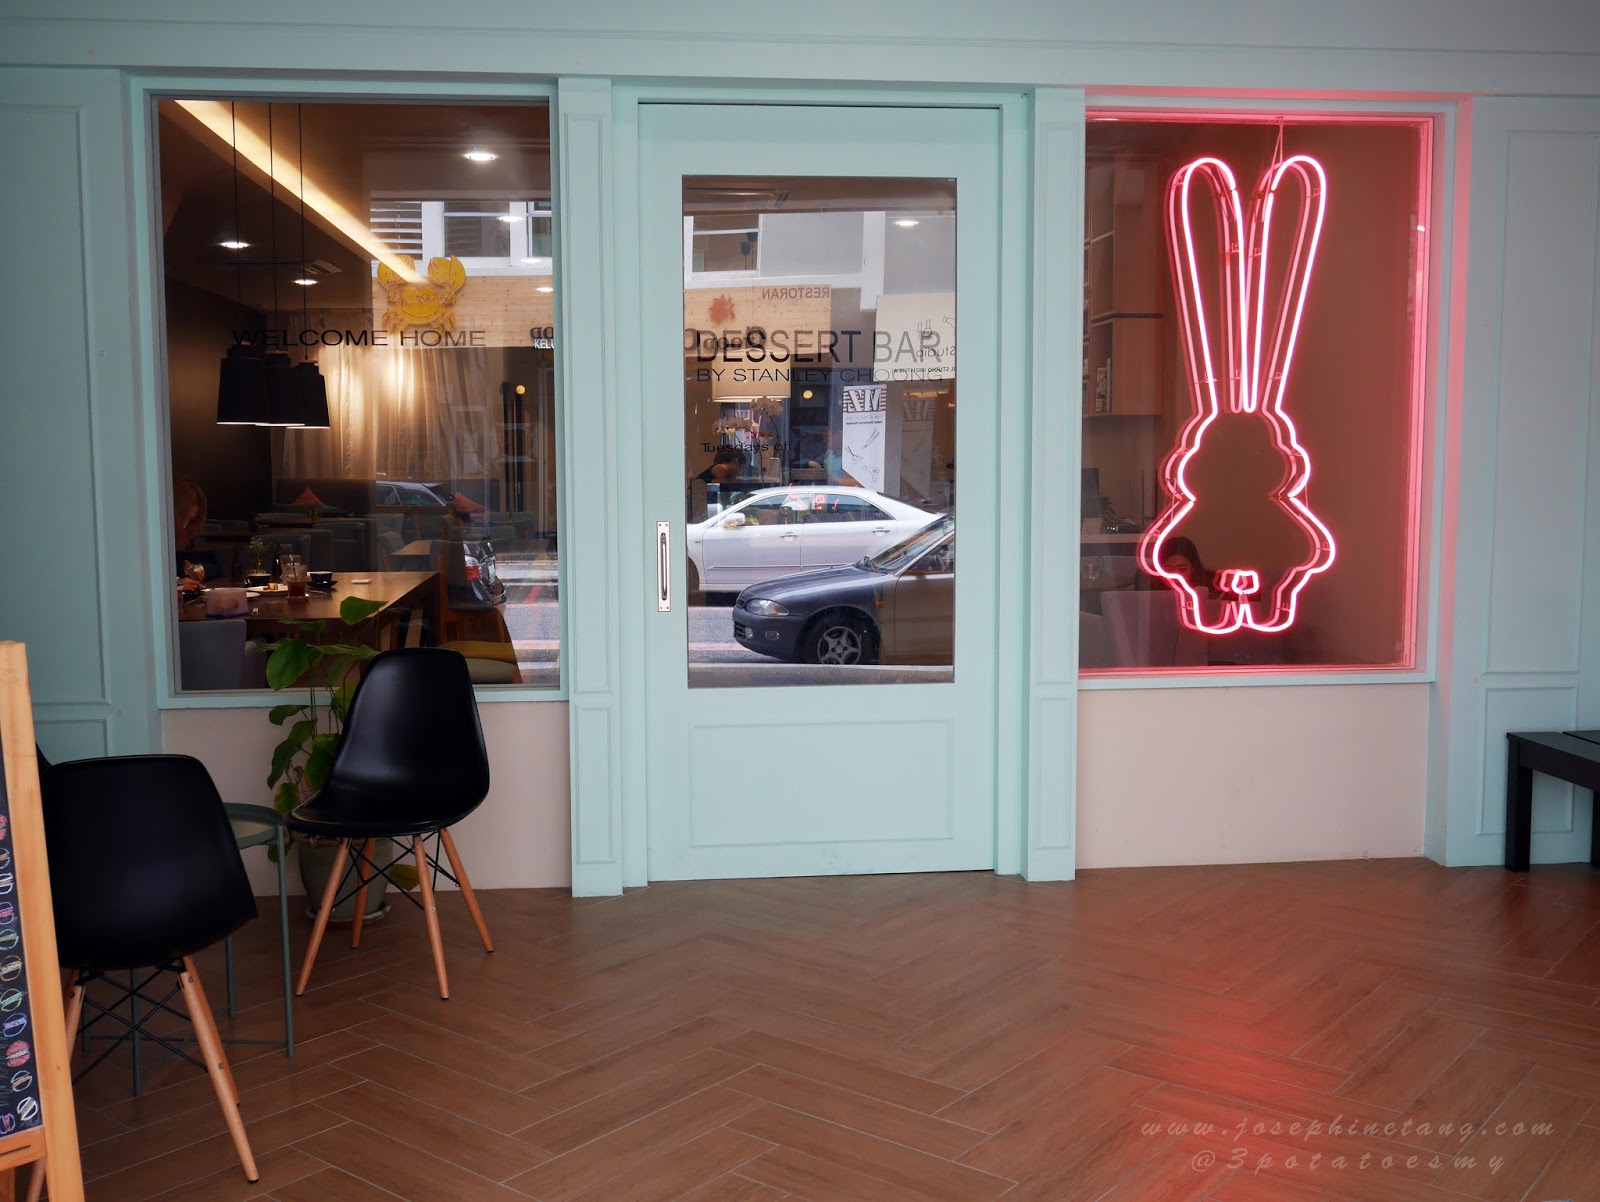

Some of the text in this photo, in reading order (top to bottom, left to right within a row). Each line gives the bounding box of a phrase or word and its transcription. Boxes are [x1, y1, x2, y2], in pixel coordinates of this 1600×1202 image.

[232, 329, 486, 347] WELCOME HOME
[697, 330, 861, 362] DESSERT
[873, 330, 942, 362] BAR
[697, 369, 725, 381] BY
[733, 369, 832, 381] STANLEY
[840, 368, 942, 382] CHOONG
[700, 442, 769, 453] Tuesdays
